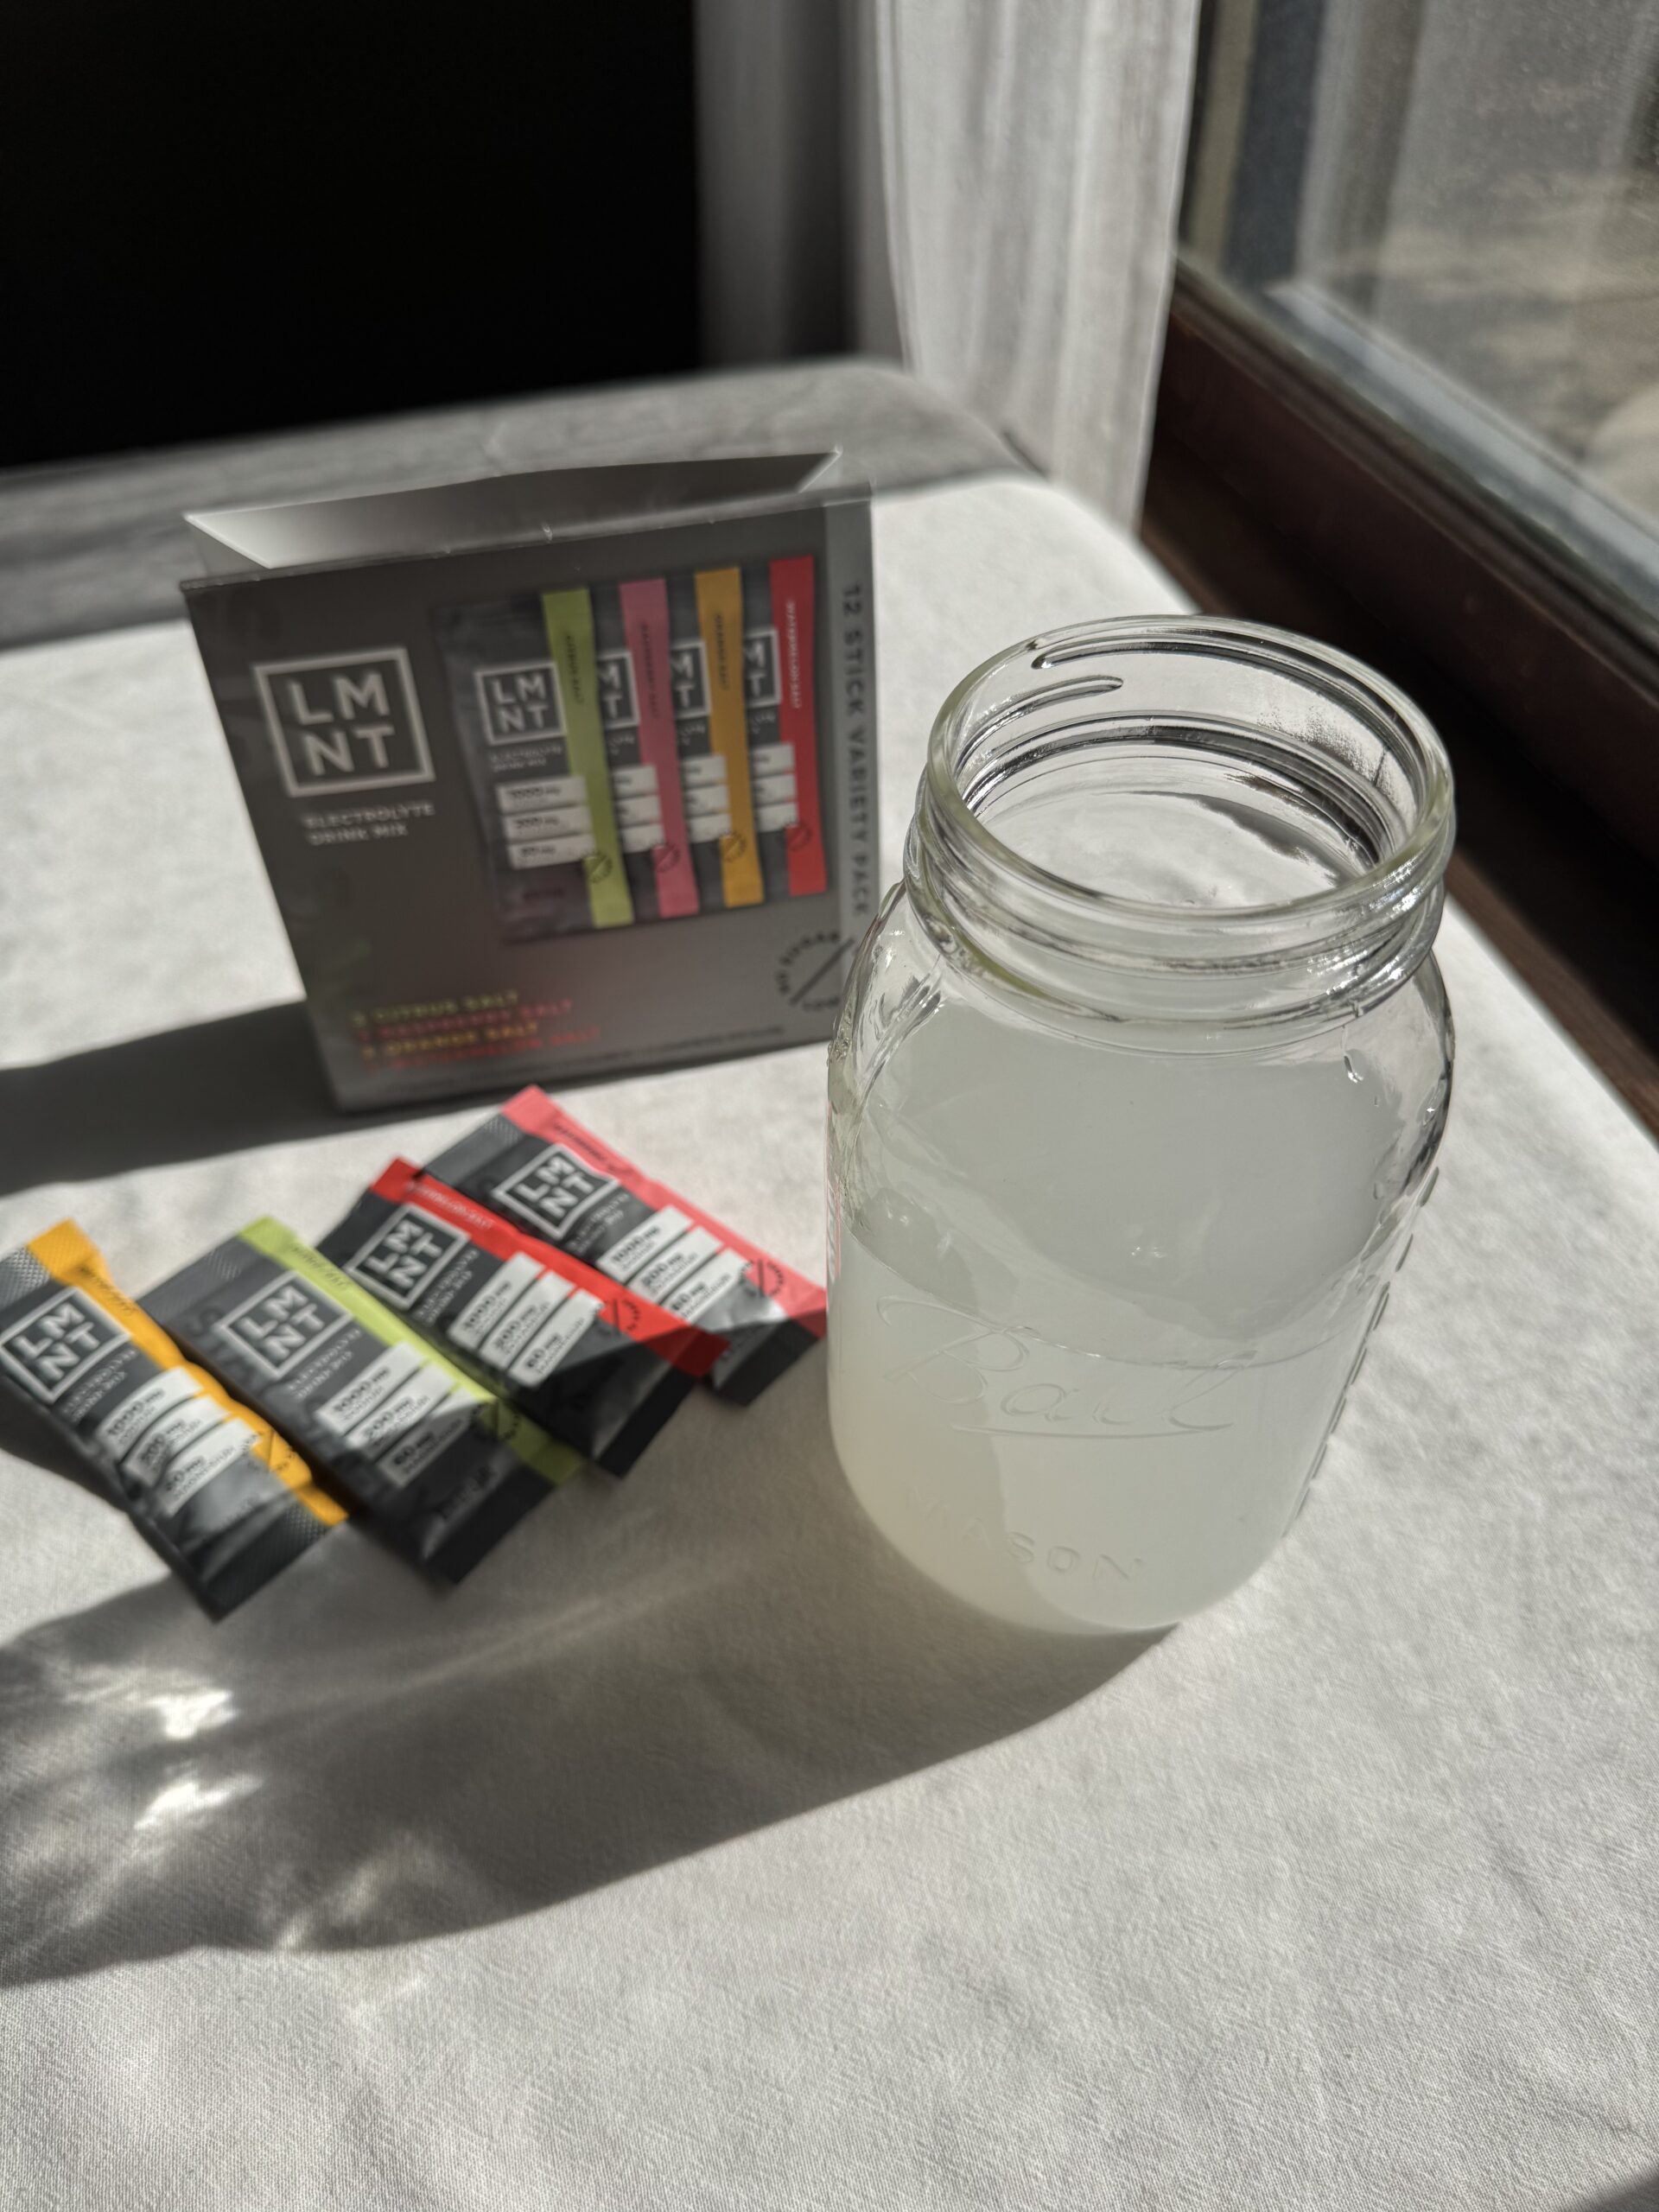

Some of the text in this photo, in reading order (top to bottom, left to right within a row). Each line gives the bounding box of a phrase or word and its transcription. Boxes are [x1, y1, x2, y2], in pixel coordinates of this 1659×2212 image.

[842, 582, 870, 917] 12 STICK VARIETY PACK
